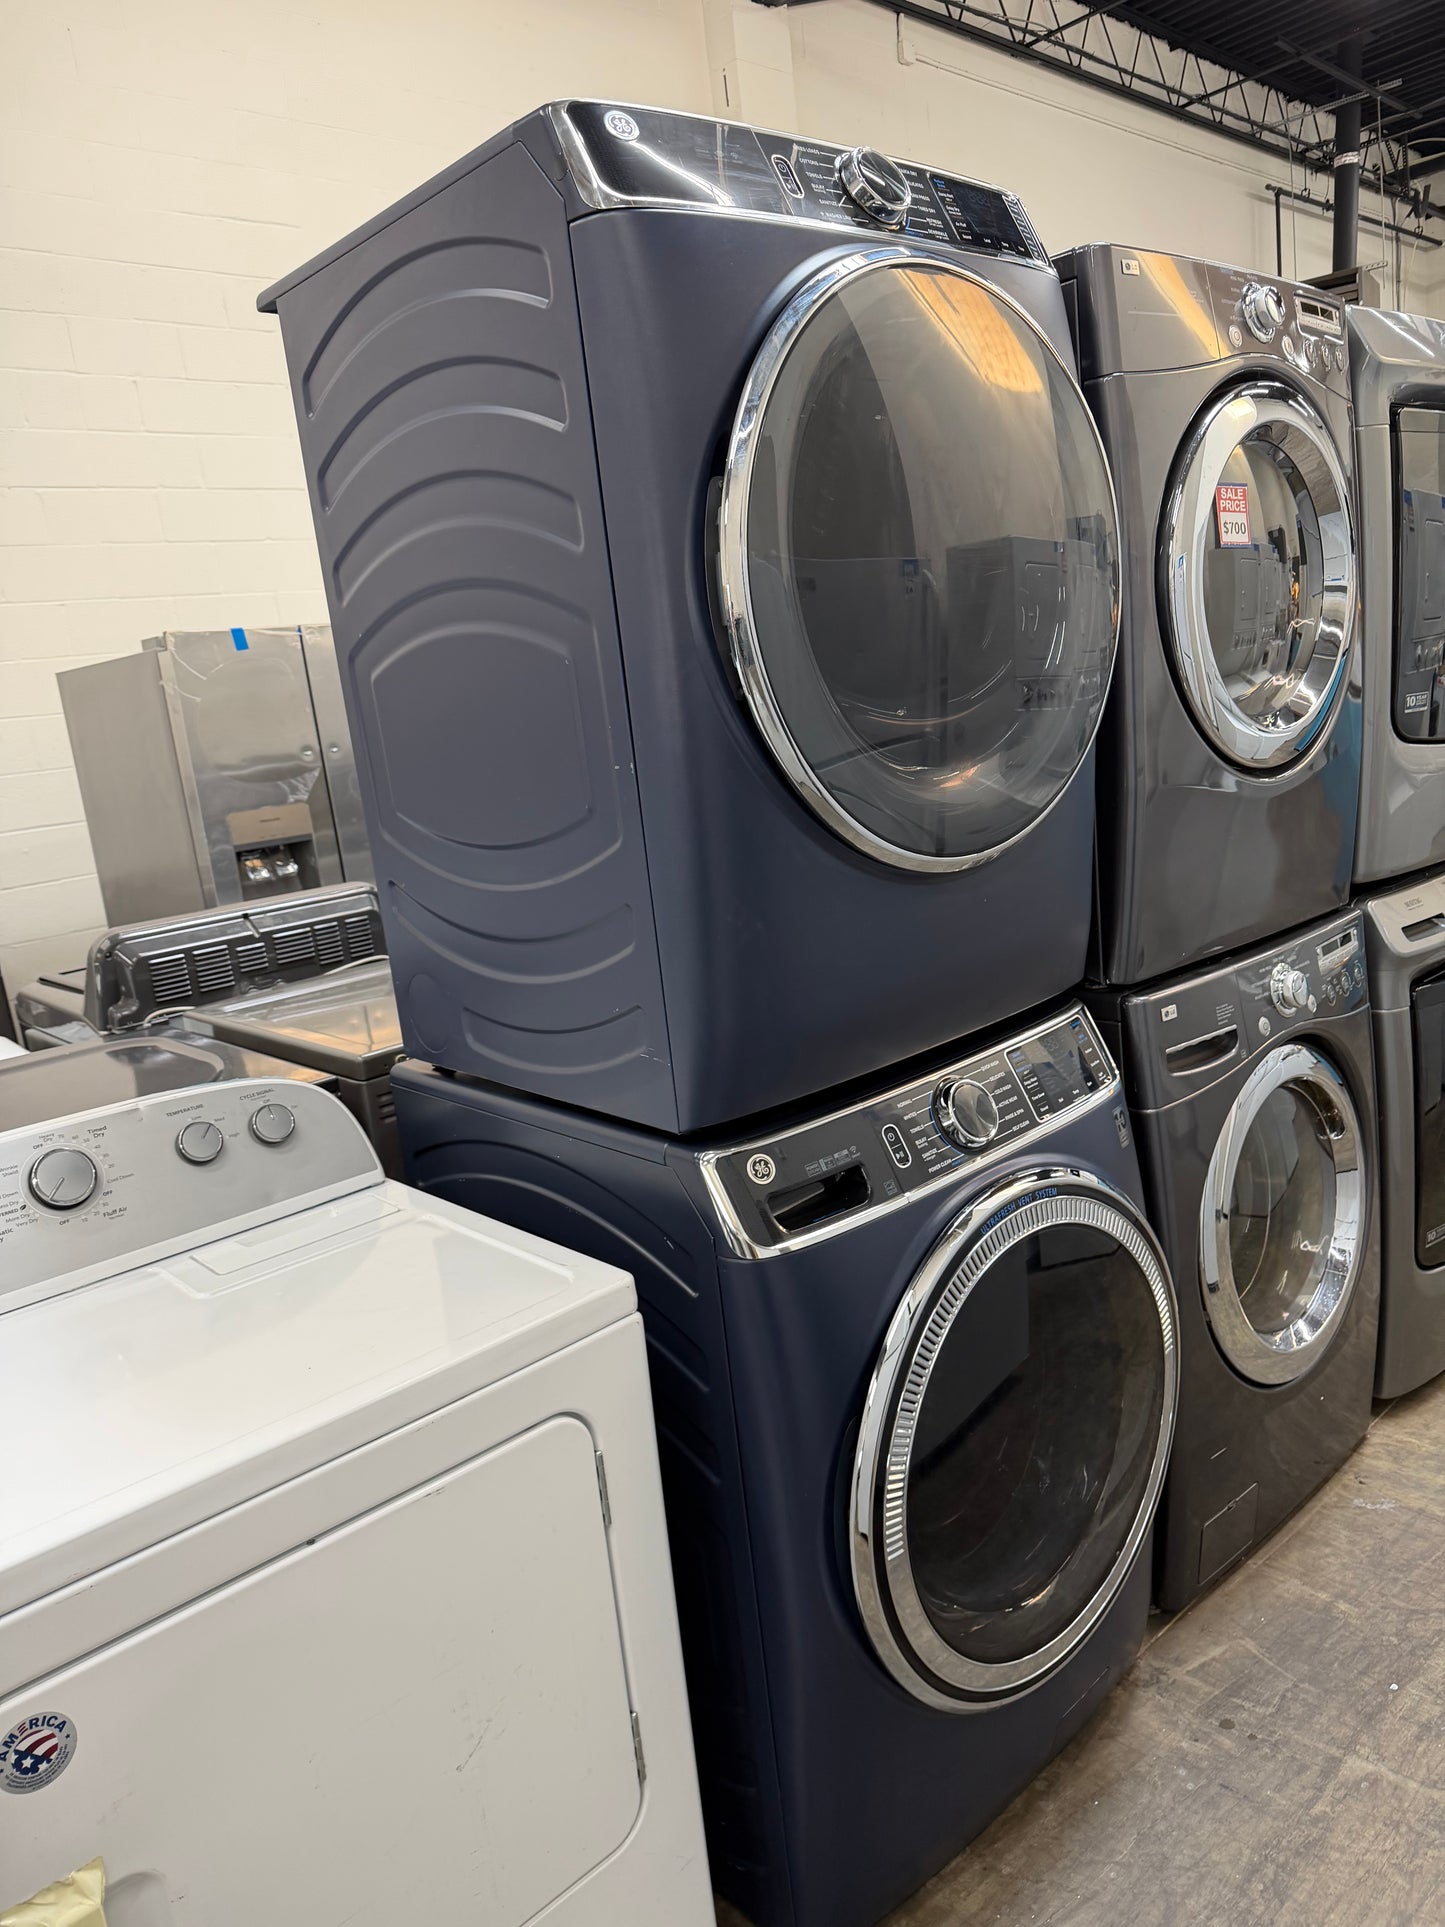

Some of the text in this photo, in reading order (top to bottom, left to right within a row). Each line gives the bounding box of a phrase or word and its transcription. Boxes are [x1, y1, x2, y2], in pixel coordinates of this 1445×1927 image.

[1220, 488, 1244, 500] SALE
[1220, 499, 1246, 512] PRICE
[1223, 520, 1246, 535] $700
[1406, 695, 1416, 708] 10
[239, 1092, 255, 1101] CYCLE
[166, 1103, 204, 1117] TEMPERATURE
[88, 1126, 107, 1136] Timed
[103, 1208, 117, 1217] Fluff
[117, 1205, 128, 1213] Air
[980, 1187, 1057, 1235] ULTRAFRESH VENT SYSTEM
[0, 1715, 66, 1762] AMERICA
